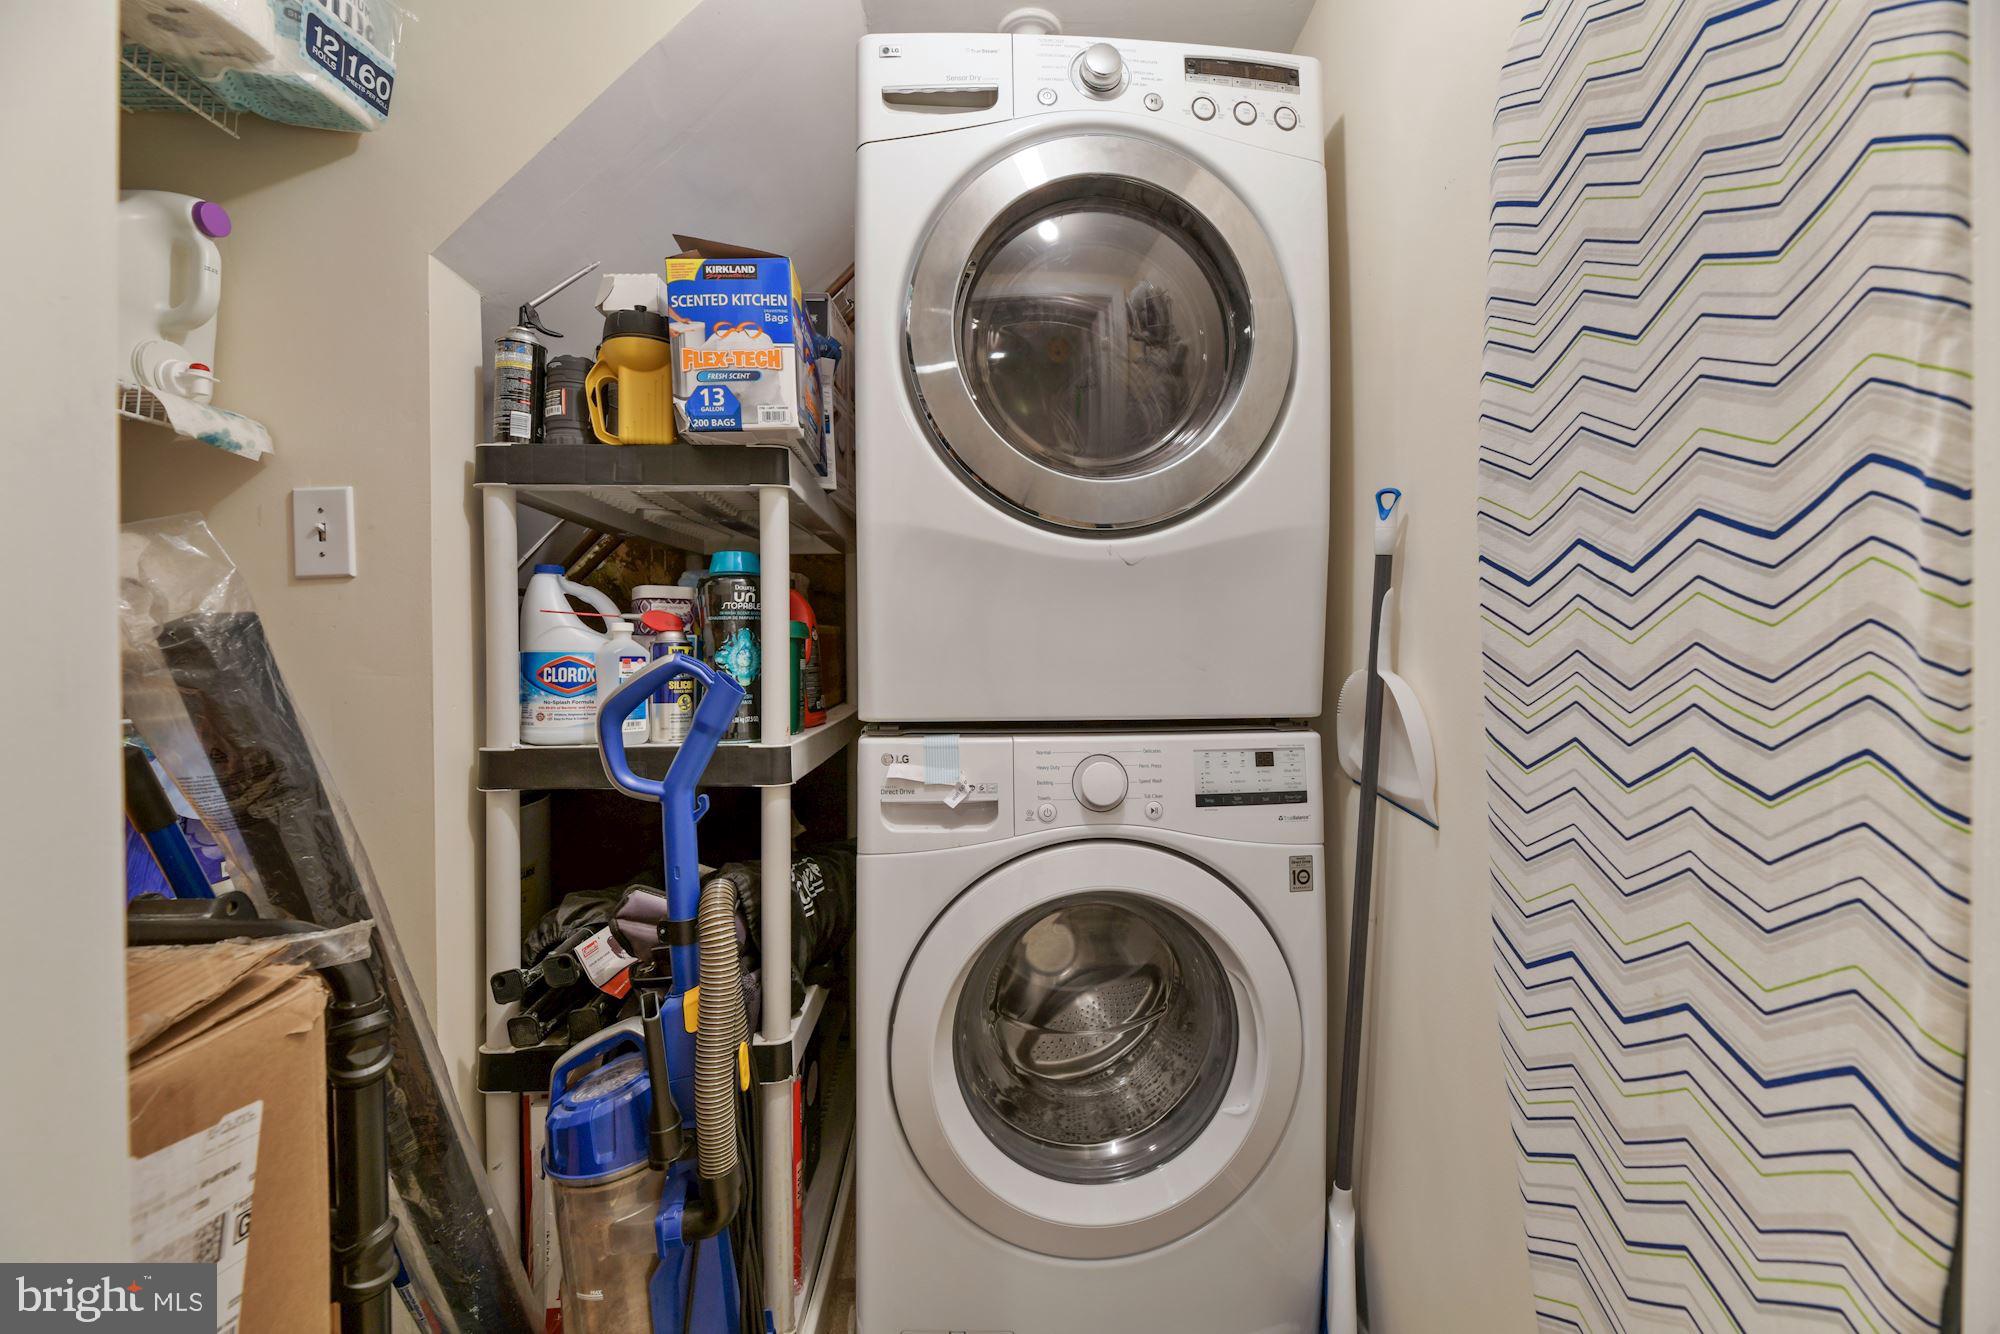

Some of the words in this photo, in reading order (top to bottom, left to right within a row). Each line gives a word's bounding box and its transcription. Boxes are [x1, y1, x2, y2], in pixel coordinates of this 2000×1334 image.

[314, 25, 340, 62] 12
[312, 45, 337, 71] ROLLS
[348, 54, 391, 101] 160
[345, 74, 366, 94] SHEETS
[365, 90, 376, 101] PER
[376, 99, 388, 111] ROLL
[705, 265, 756, 274] KIRKLAND
[671, 294, 728, 308] SCENTED
[731, 293, 788, 307] KITCHEN
[764, 313, 789, 324] Bags
[681, 347, 783, 372] FLEX-TECH
[728, 372, 751, 380] SCENT
[699, 387, 725, 406] 13
[693, 419, 709, 427] 200
[711, 418, 736, 427] BAGS
[543, 667, 596, 683] CLOROX
[895, 755, 910, 764] LG
[1292, 869, 1311, 885] 10
